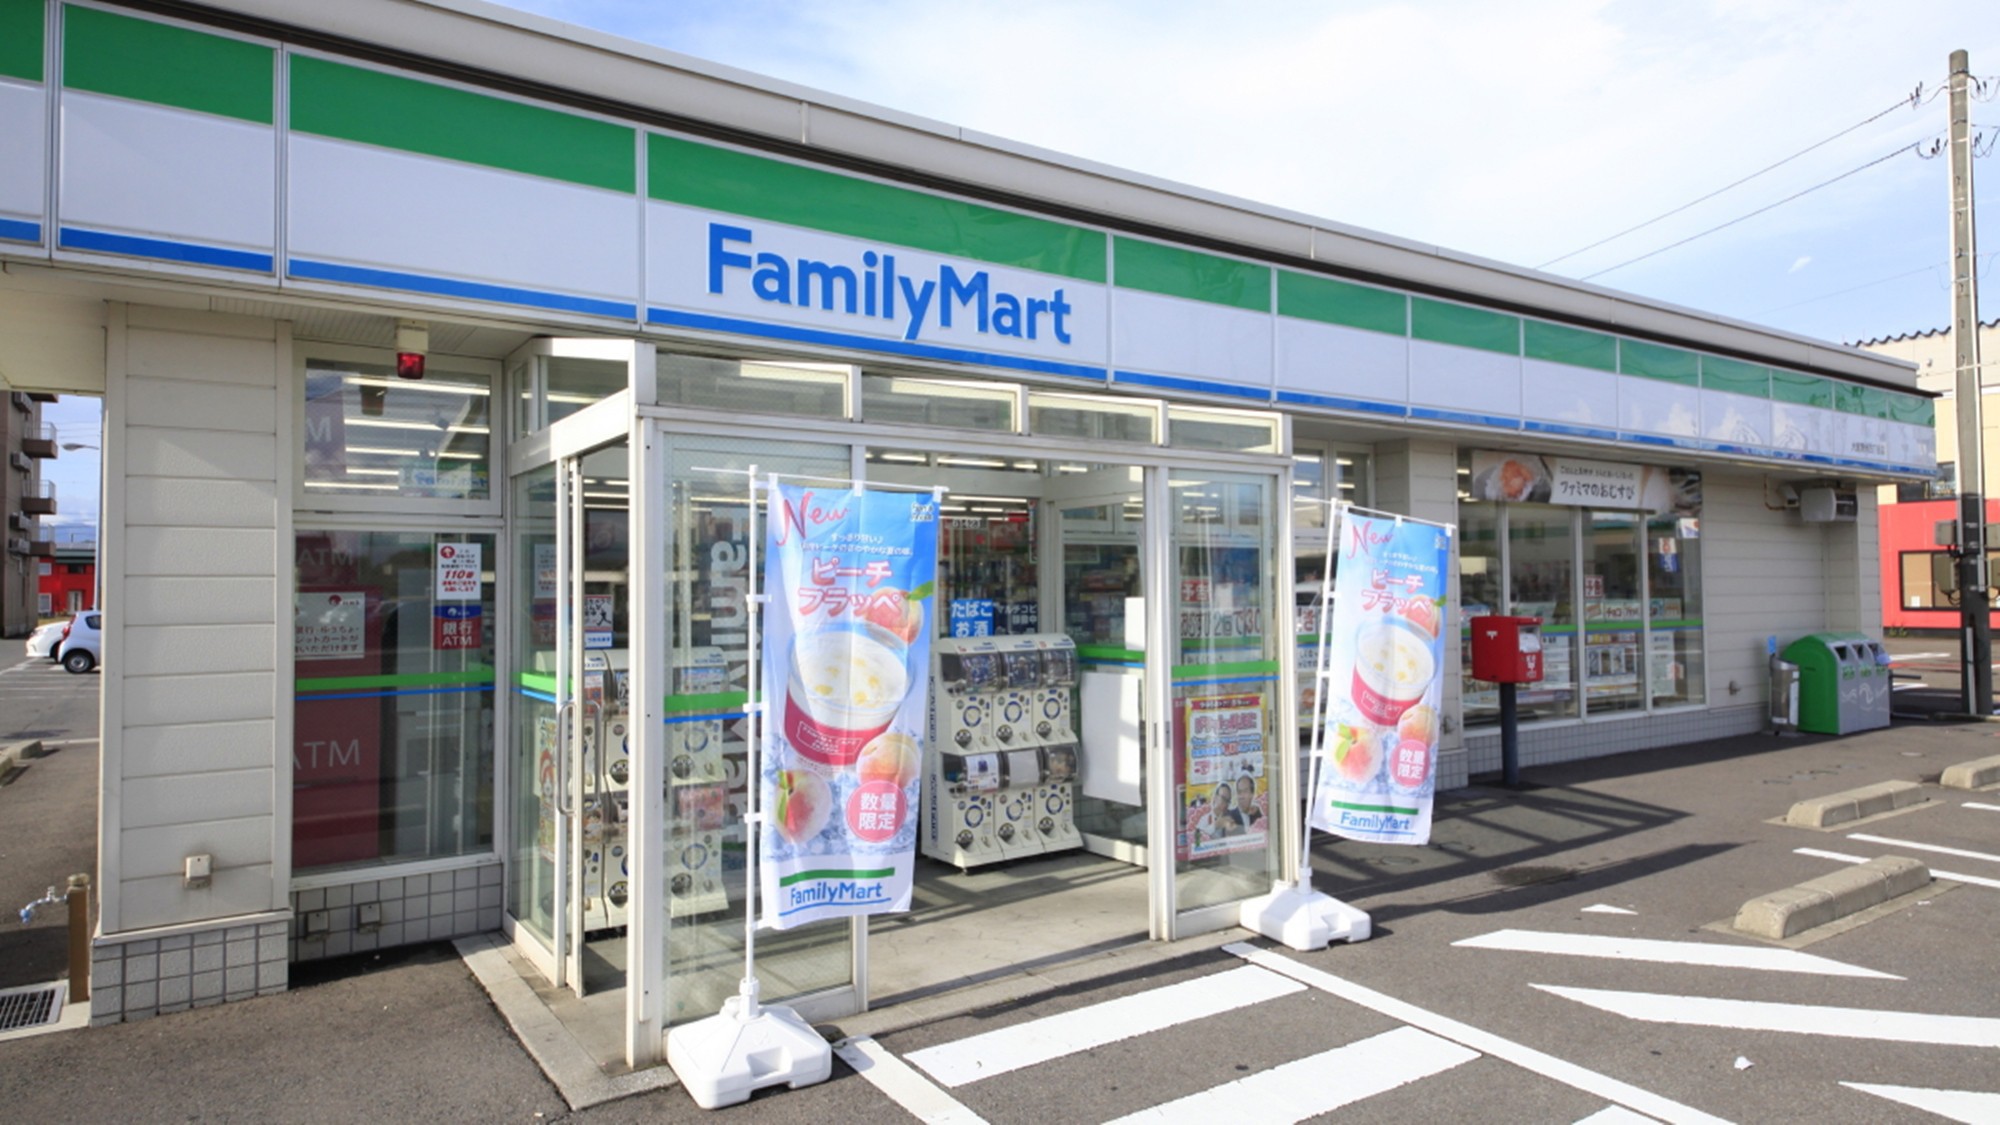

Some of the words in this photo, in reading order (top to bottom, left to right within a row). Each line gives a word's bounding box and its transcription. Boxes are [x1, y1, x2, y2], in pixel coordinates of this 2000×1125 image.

[707, 222, 1071, 345] FamilyMart
[1560, 480, 1635, 500] ファミマのおむすび
[776, 491, 848, 546] New
[1347, 520, 1394, 560] New
[299, 548, 353, 566] ATM
[811, 556, 893, 588] ピーチ
[1371, 567, 1424, 594] ピーチ
[798, 588, 904, 617] フラッペ
[951, 601, 993, 618] たばこ
[1361, 589, 1432, 617] フラッペ
[443, 621, 473, 636] 銀行
[955, 620, 989, 638] お酒
[443, 636, 472, 647] ATM
[860, 793, 897, 811] 数量
[858, 812, 896, 831] 限定
[1340, 811, 1411, 832] FamilyMart
[790, 881, 883, 907] FamilyMart
